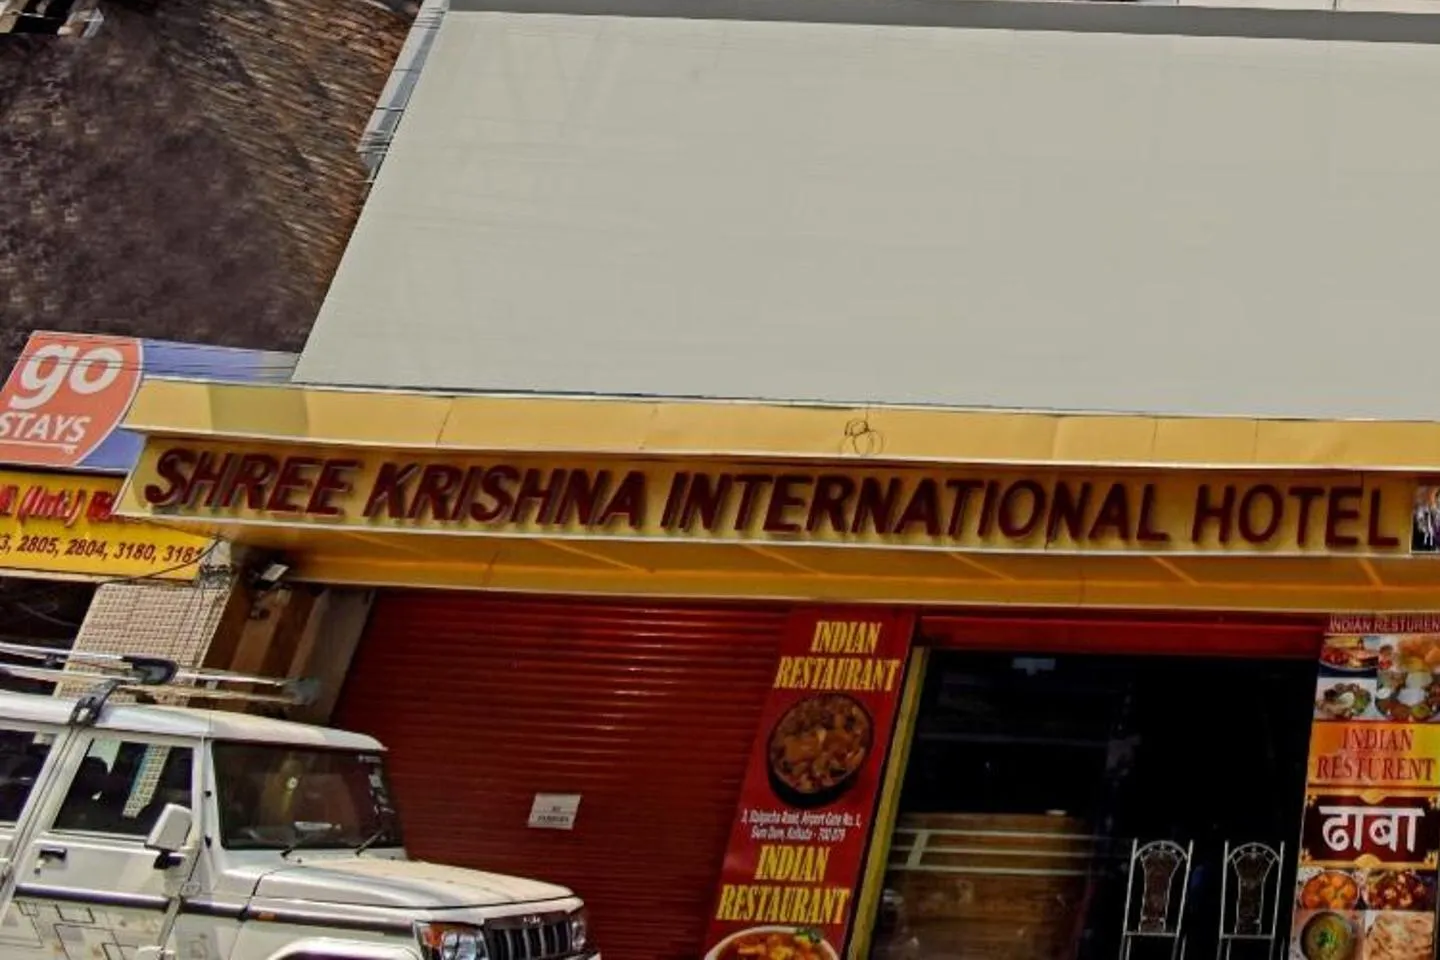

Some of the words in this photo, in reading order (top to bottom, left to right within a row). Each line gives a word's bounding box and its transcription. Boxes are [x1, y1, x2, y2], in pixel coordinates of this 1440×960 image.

[8, 344, 122, 410] go
[0, 411, 92, 442] STAYS
[145, 446, 361, 517] SHREE
[364, 460, 649, 529] KRISHNA
[660, 470, 1169, 542] INTERNATIONAL
[1191, 484, 1399, 549] HOTEL
[17, 535, 59, 557] 2805,
[64, 538, 107, 560] 2804,
[810, 620, 882, 654] INDIAN
[773, 657, 900, 692] RESTAURANT
[1341, 728, 1414, 752] INDIAN
[1316, 757, 1435, 781] RESTURENT
[1319, 805, 1425, 853] ढाबा
[754, 845, 830, 881] INDIAN
[716, 885, 850, 924] RESTAURANT
